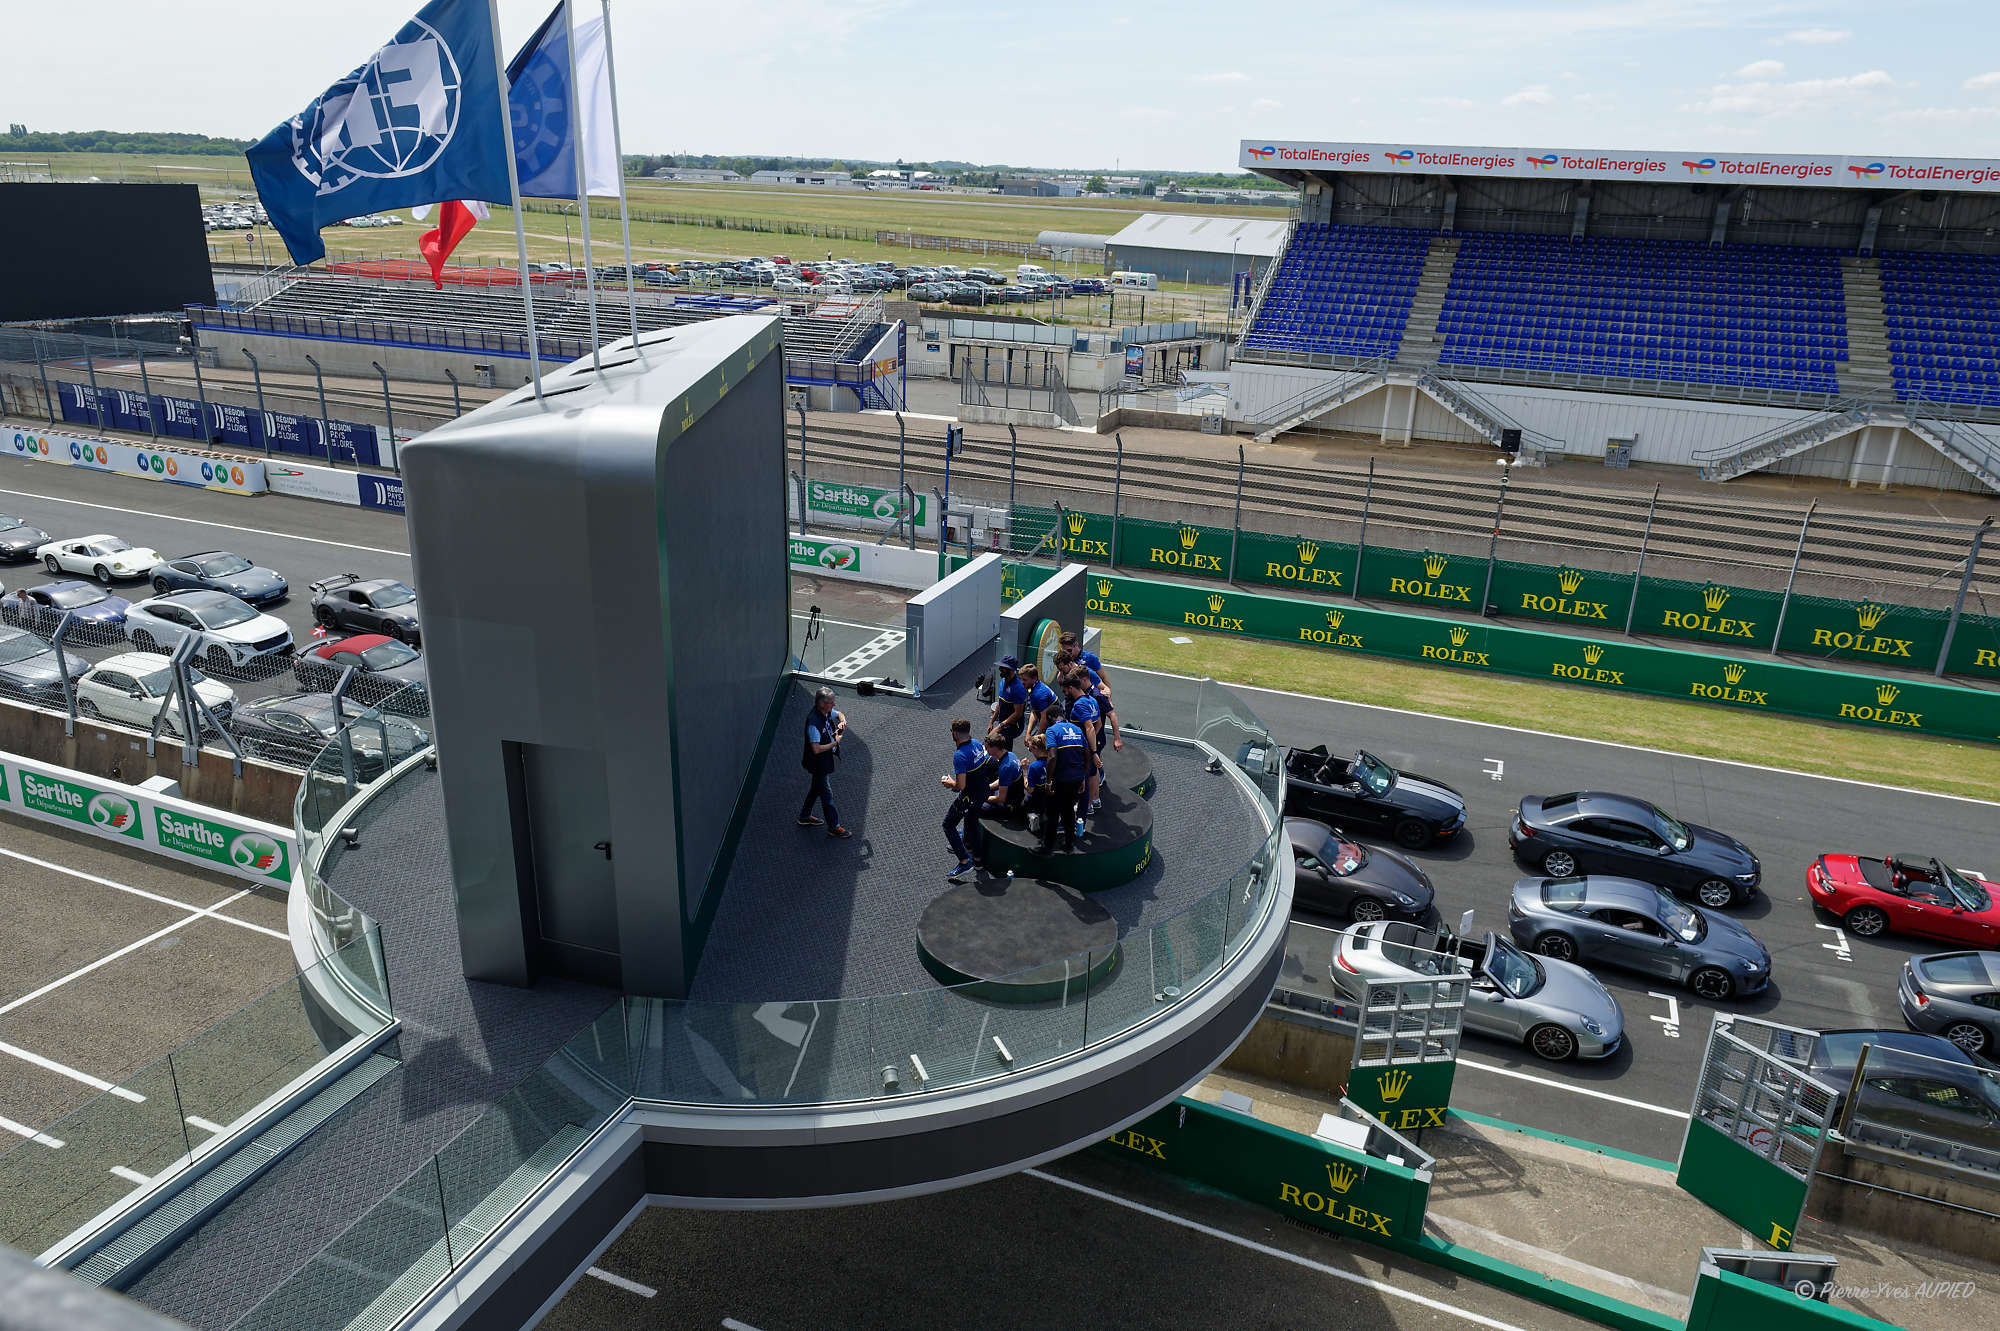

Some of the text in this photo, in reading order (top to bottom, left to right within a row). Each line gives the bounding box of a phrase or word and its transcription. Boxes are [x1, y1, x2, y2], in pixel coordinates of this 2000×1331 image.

[1278, 147, 1370, 164] TotalEnergies
[1417, 152, 1515, 170] TotalEnergies
[1561, 156, 1667, 175] TotalEnergies
[1719, 160, 1833, 180] TotalEnergies
[1888, 164, 2000, 184] TotalEnergie
[276, 423, 291, 433] PAYS
[330, 431, 346, 440] PAYS
[386, 485, 404, 494] RÉGIO
[813, 484, 869, 506] Sarthe
[790, 543, 816, 557] rthe
[1151, 549, 1222, 571] ROLEX
[1266, 562, 1343, 587] ROLEX
[1390, 577, 1471, 602] ROLEX
[1086, 598, 1132, 615] OLEX
[1521, 593, 1608, 620] ROLEX
[1184, 612, 1244, 631] ROLEX
[1662, 610, 1756, 638] ROLEX
[1299, 628, 1363, 648] ROLEX
[1812, 629, 1913, 657] ROLEX
[1421, 646, 1489, 666] ROLEX
[1552, 663, 1625, 685] ROLEX
[1691, 682, 1769, 705] ROLEX
[1838, 703, 1924, 727] ROLEX
[24, 775, 84, 808] Sarthe
[160, 813, 225, 848] Sarthe
[1378, 1107, 1447, 1130] LEX
[1108, 1130, 1166, 1160] LEX
[1279, 1182, 1393, 1238] ROLEX
